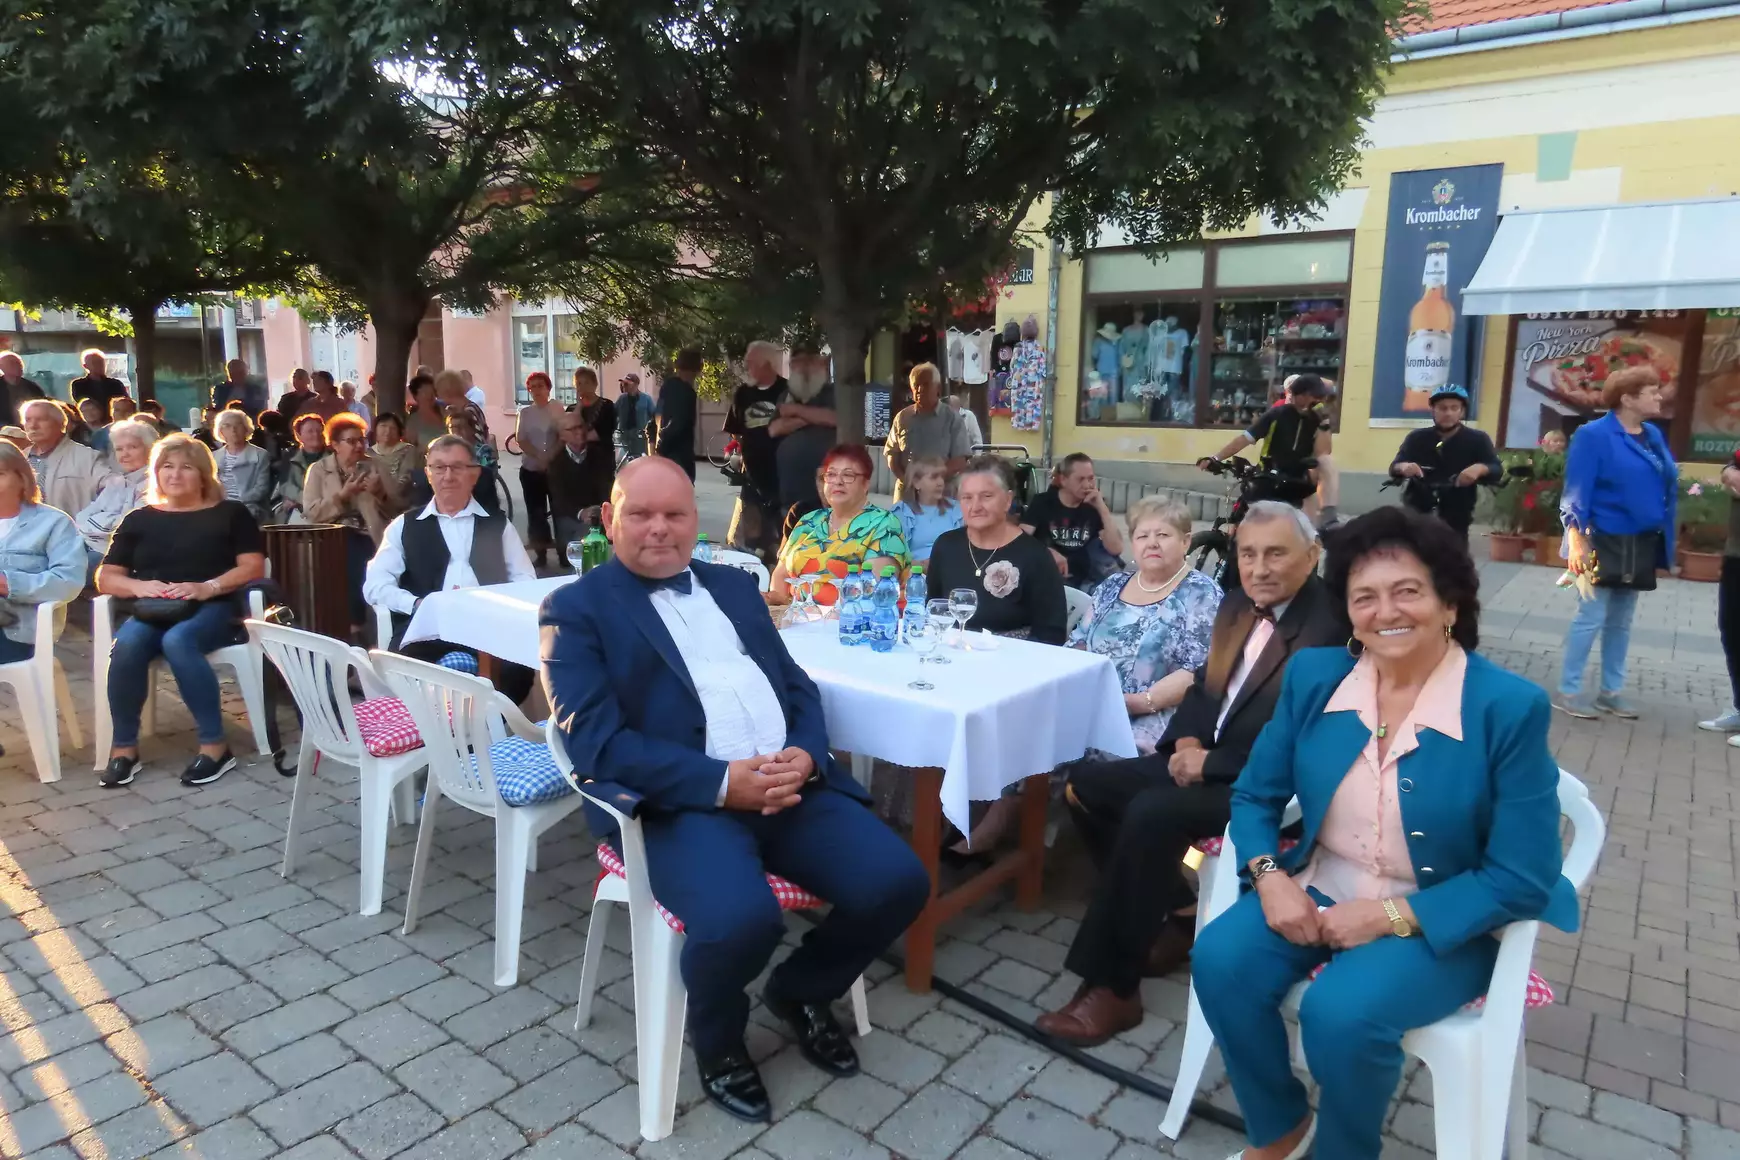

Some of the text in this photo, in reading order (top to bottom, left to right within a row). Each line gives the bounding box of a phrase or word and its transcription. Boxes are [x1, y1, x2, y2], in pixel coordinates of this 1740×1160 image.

[1406, 204, 1481, 225] Krombacher
[1537, 324, 1593, 341] New York
[1521, 335, 1601, 372] Pizza
[1051, 529, 1090, 541] SURF
